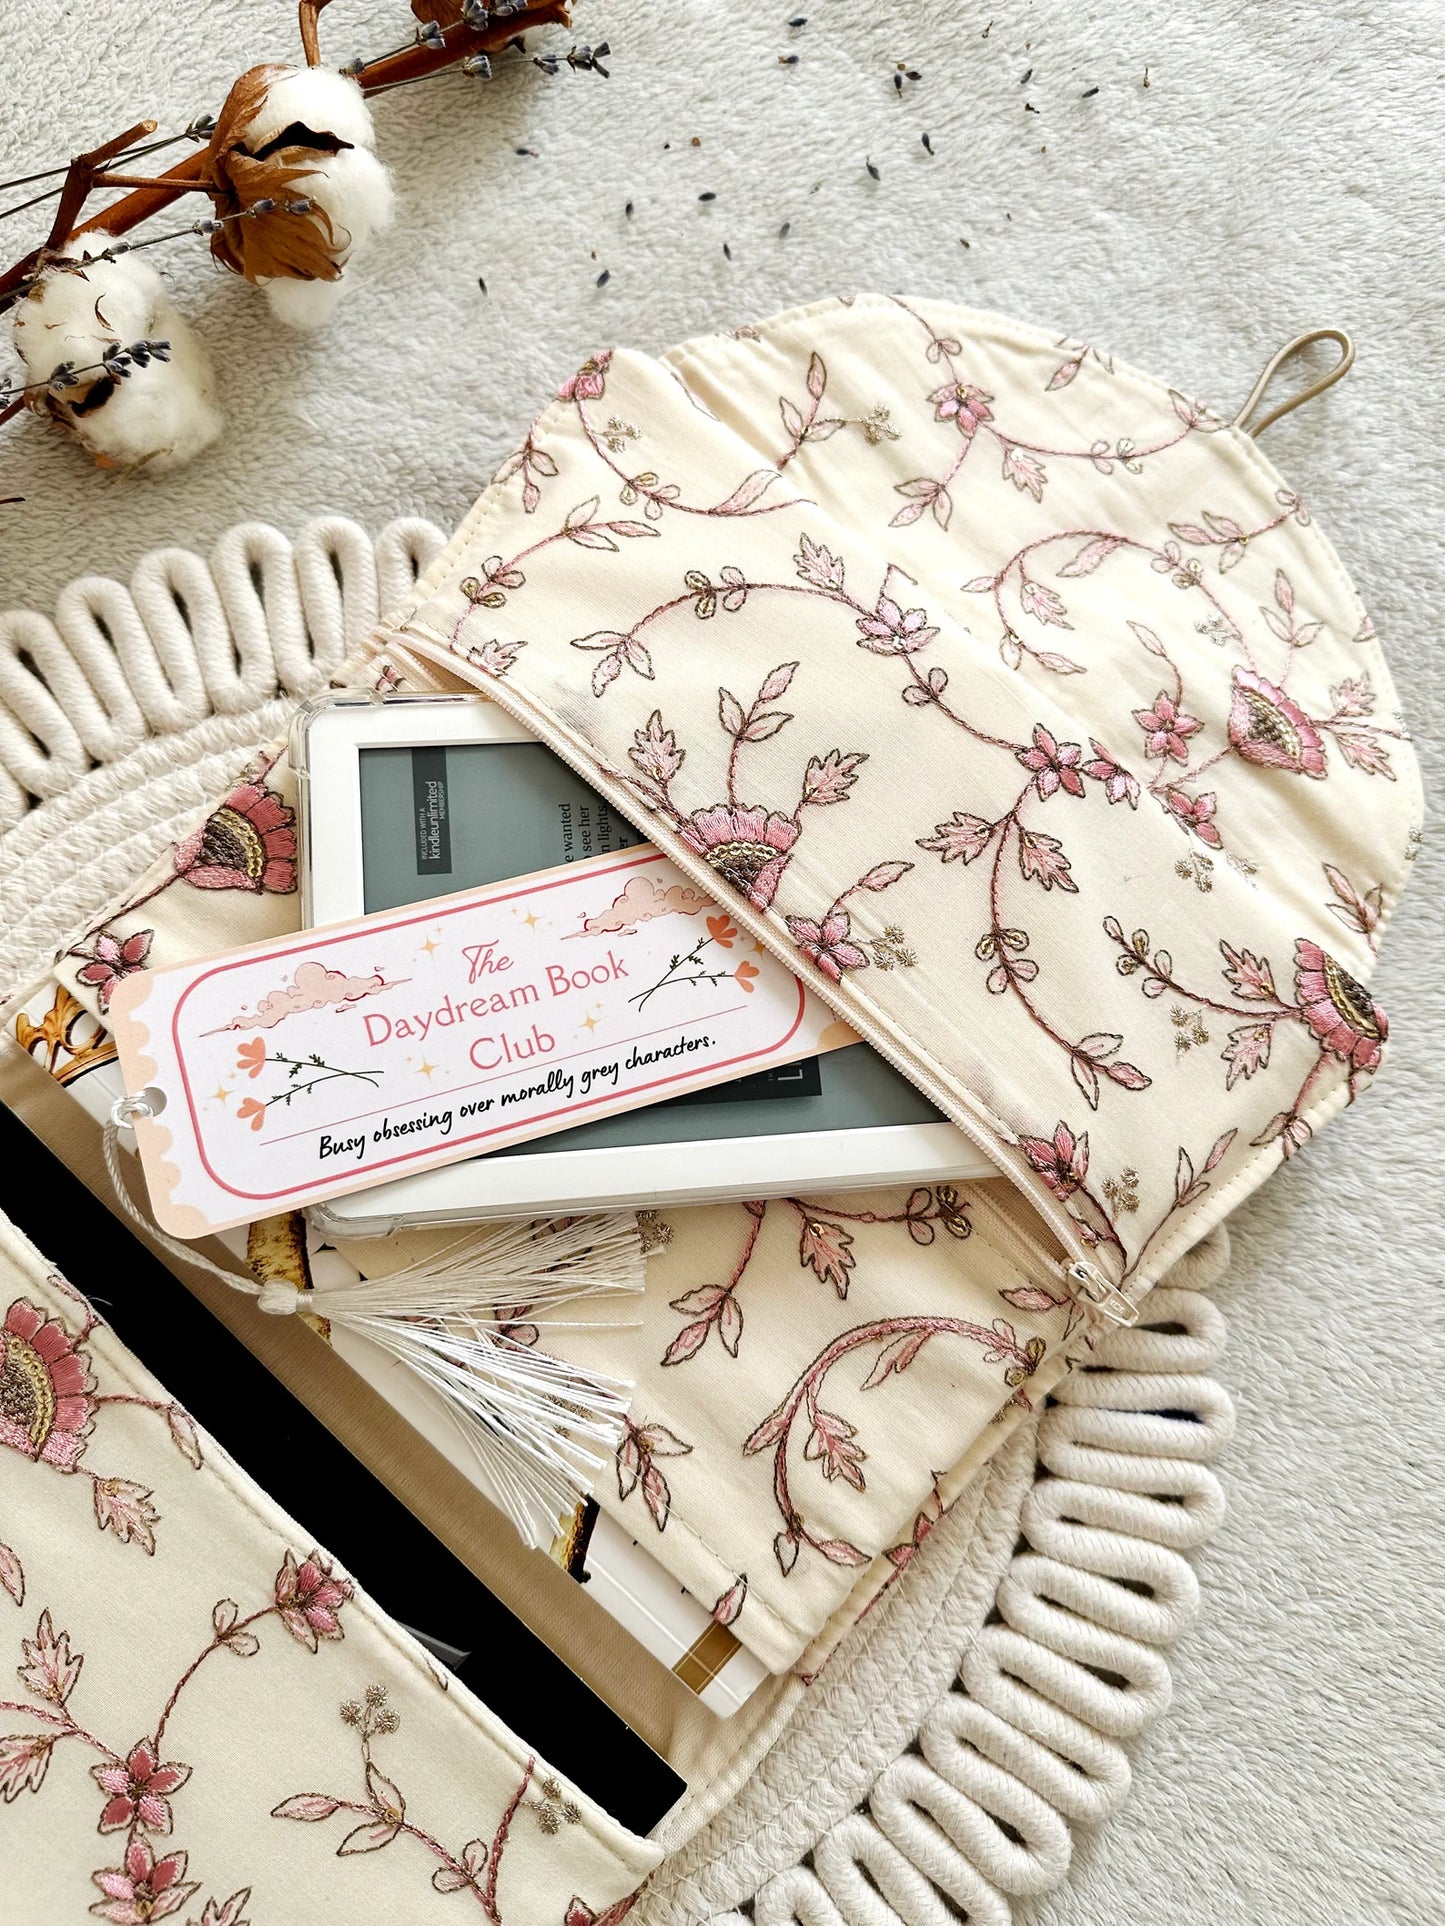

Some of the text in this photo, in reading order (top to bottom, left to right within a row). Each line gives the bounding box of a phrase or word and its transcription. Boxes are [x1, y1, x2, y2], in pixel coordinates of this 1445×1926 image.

[419, 814, 427, 829] WITH
[425, 781, 441, 860] kindleunlimited
[558, 803, 573, 852] wanted
[578, 805, 590, 827] her
[420, 830, 428, 860] INCLUDED
[581, 830, 592, 852] see
[461, 939, 515, 984] The
[362, 950, 630, 1047] Daydream Book
[468, 1023, 556, 1070] Club
[319, 1036, 716, 1160] Busy obsessing over morally grey characters.
